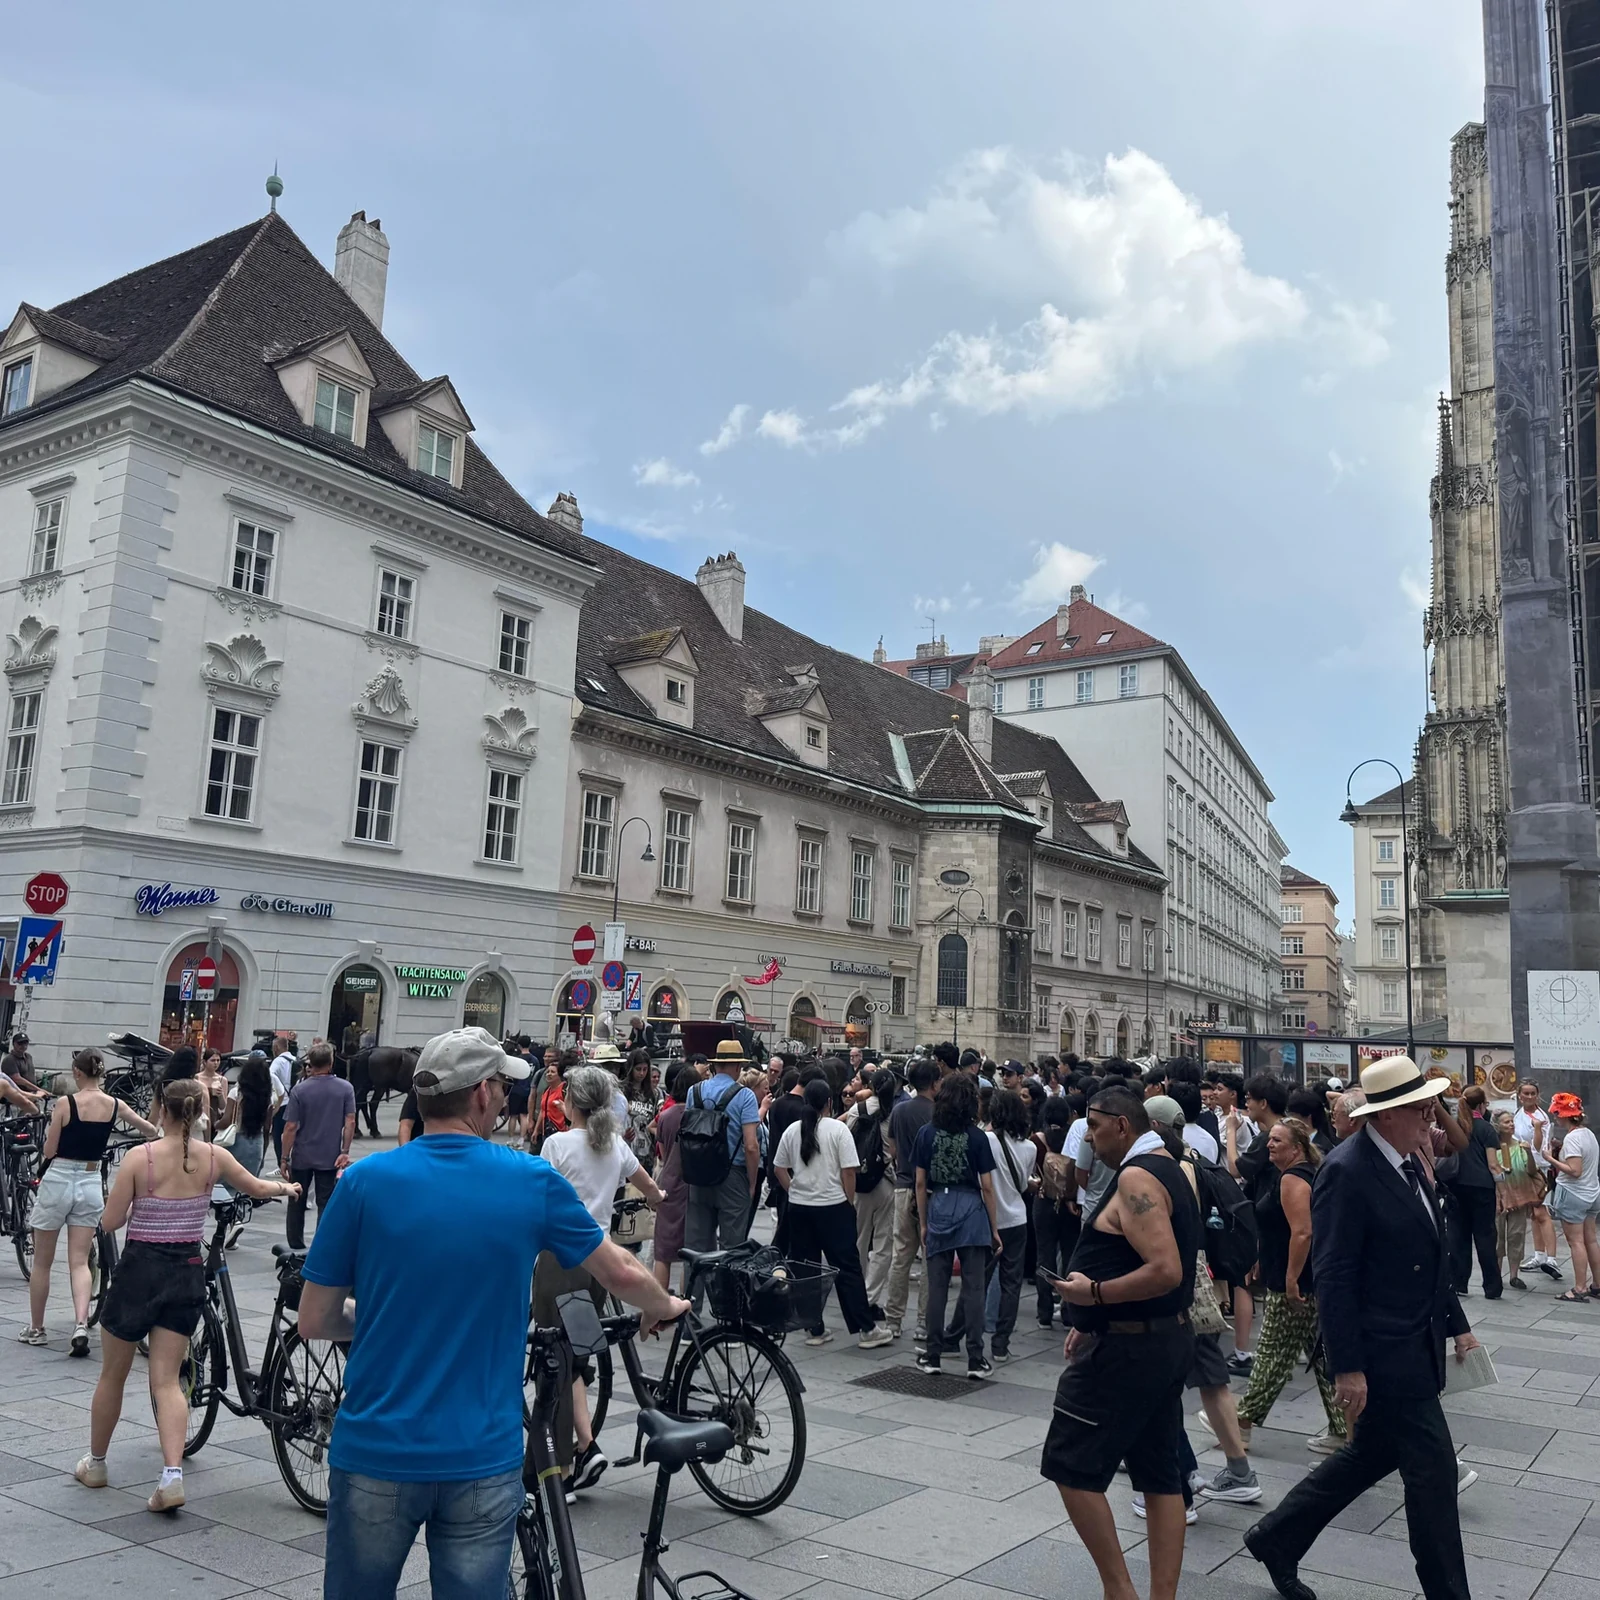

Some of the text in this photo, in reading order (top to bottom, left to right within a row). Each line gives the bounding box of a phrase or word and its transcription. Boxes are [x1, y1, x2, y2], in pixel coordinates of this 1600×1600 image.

[29, 885, 65, 902] STOP
[136, 882, 220, 917] Manner
[273, 897, 333, 918] Giarolli
[396, 965, 467, 980] TRACHTENSALON
[345, 977, 377, 986] GEIGER
[409, 983, 454, 997] WITZKY
[465, 1002, 491, 1012] EDERHOSE
[1563, 1039, 1597, 1047] PUMMER
[1360, 1046, 1406, 1058] Mozart?
